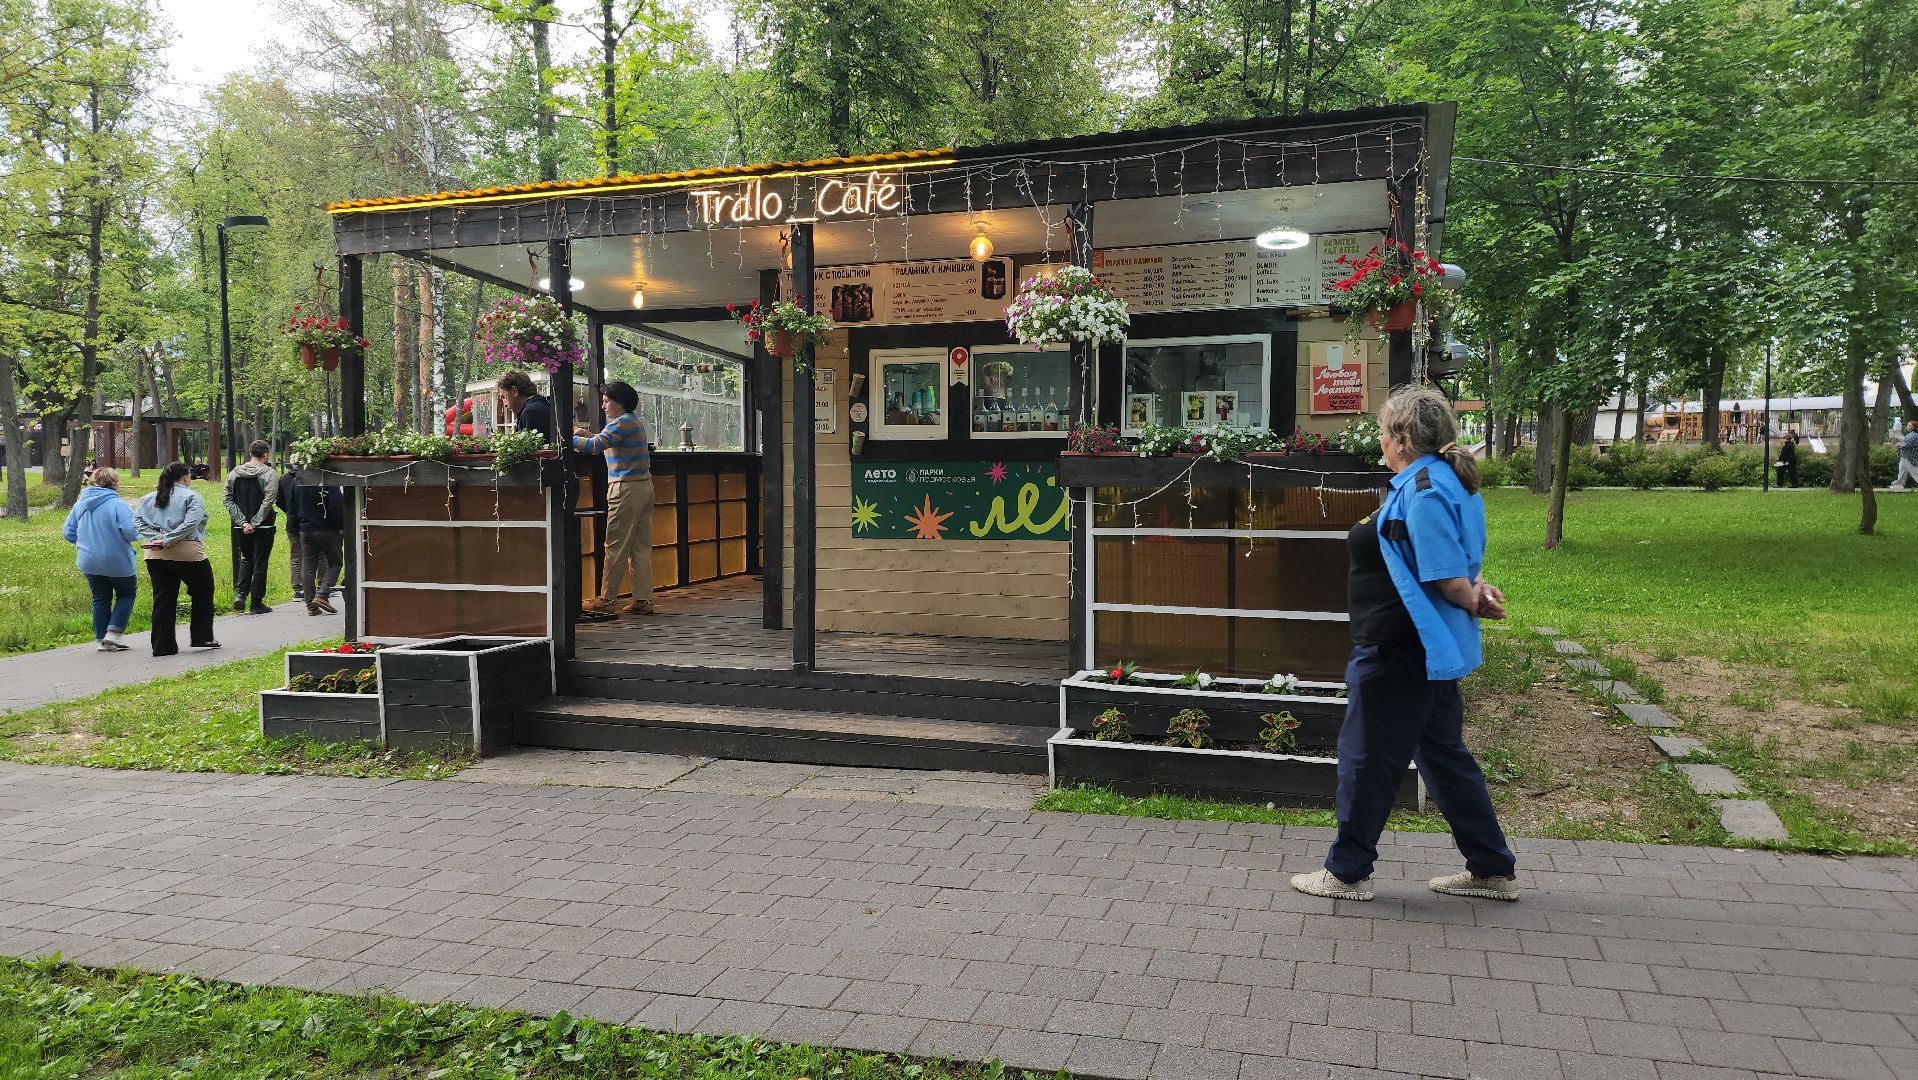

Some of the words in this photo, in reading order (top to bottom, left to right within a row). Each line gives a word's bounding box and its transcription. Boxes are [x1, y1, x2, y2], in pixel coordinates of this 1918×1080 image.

[690, 179, 783, 224] Trdlo
[817, 171, 901, 216] Café
[919, 468, 944, 476] ПАРКИ
